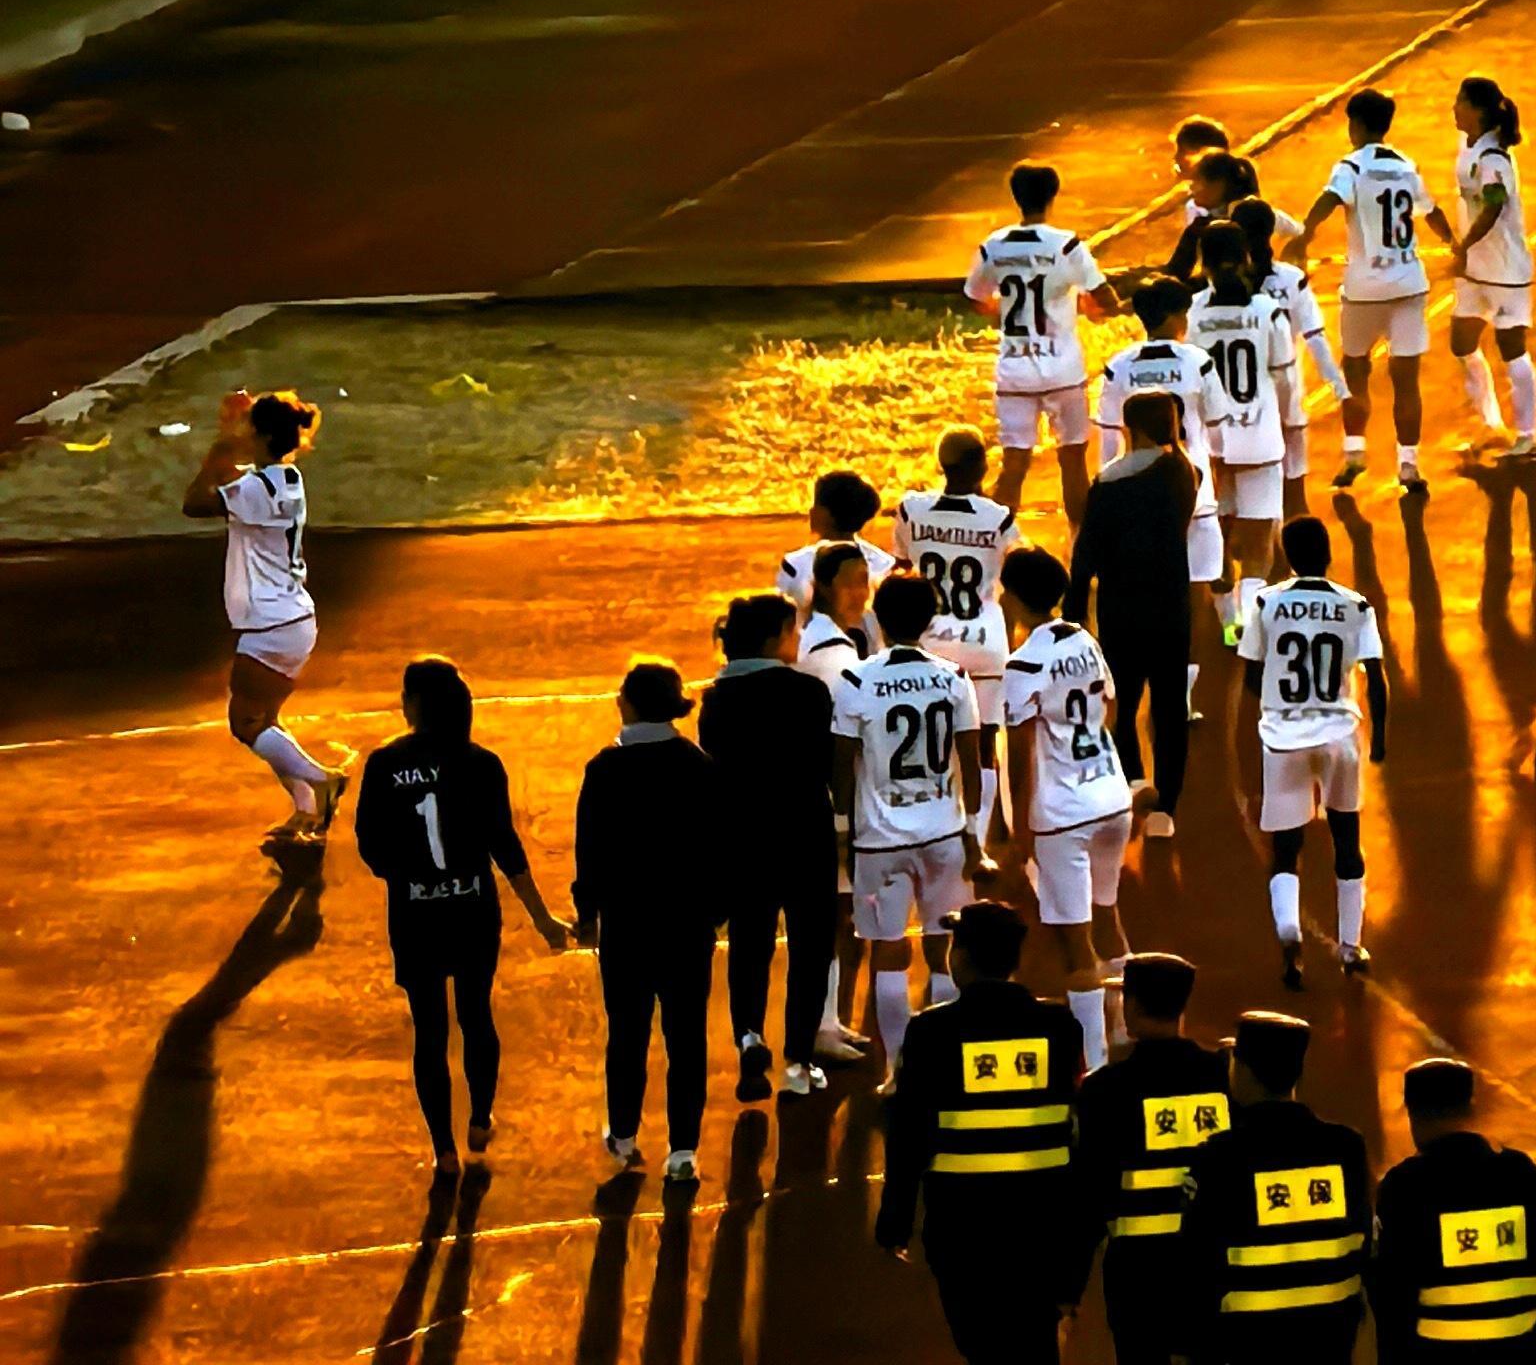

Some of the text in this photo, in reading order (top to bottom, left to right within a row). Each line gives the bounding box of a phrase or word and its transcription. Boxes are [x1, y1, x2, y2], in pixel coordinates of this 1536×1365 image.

[1376, 187, 1415, 249] 13
[999, 273, 1048, 337] 21
[1208, 338, 1258, 404] 10
[1273, 600, 1347, 622] ADELE
[1276, 631, 1344, 703] 30
[886, 698, 954, 780] 20
[415, 792, 447, 870] 1
[973, 1051, 1038, 1080] 安保
[1155, 1105, 1219, 1136] 安保
[1266, 1178, 1333, 1211] 安保
